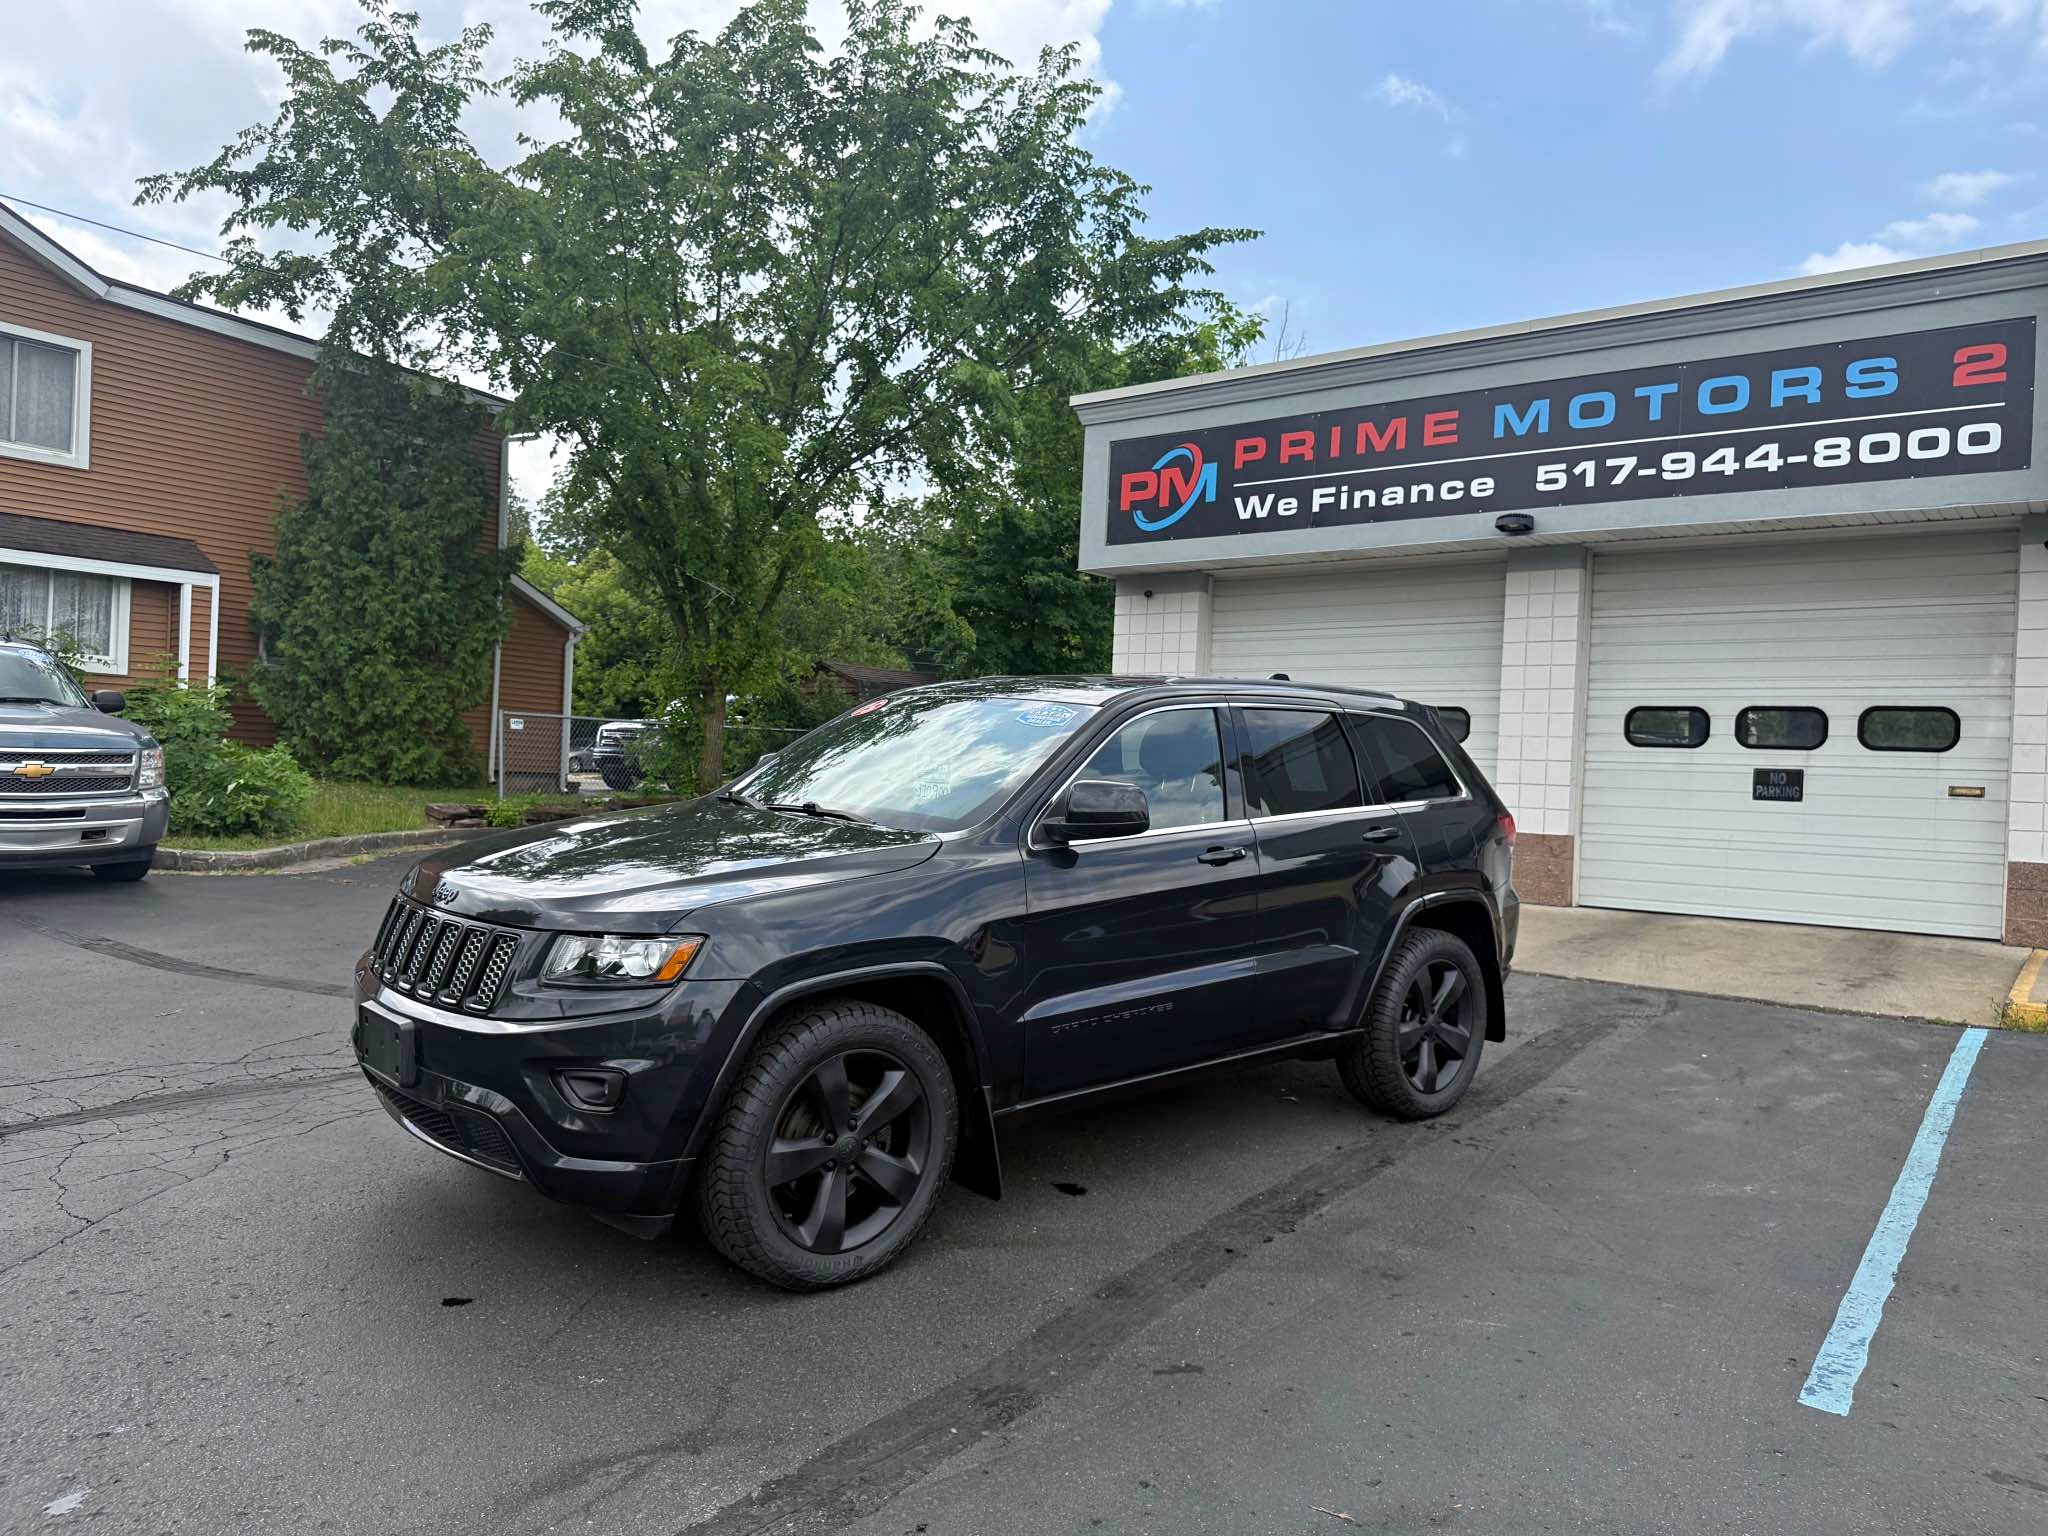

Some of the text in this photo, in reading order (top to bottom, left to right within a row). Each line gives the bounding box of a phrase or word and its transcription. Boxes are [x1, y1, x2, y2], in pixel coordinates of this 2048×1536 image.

[1233, 343, 2008, 469] PRIME MOTORS 2
[1234, 422, 2002, 520] We Finance 517-944-8000
[1756, 785, 1800, 798] PARKING
[1769, 772, 1787, 784] NO
